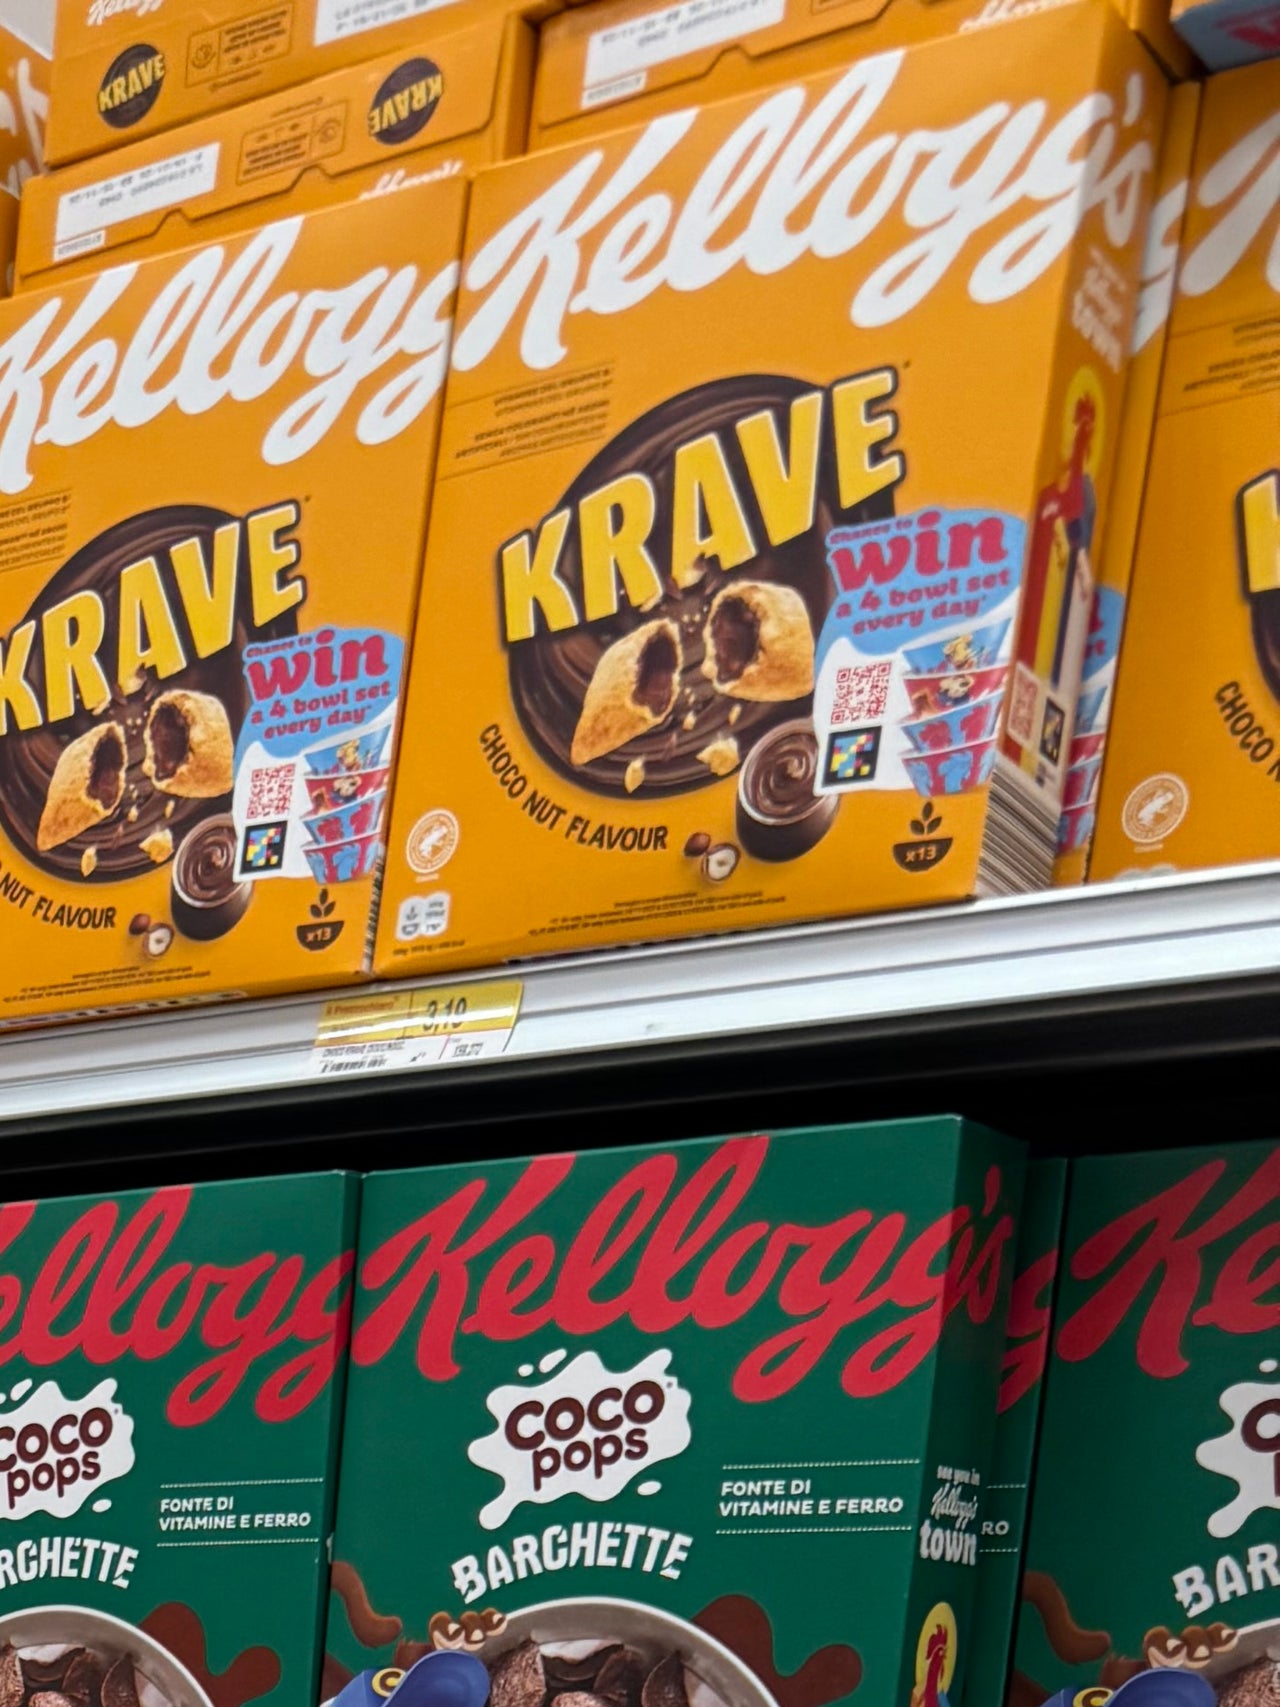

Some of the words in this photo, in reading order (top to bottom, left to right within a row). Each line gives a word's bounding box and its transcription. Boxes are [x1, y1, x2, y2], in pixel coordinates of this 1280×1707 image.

[500, 370, 902, 644] KRAVE
[833, 512, 1009, 594] win
[247, 629, 388, 702] win
[480, 724, 522, 800] CHOCO
[522, 790, 562, 831] NUT
[565, 816, 667, 852] FLAVOUR
[2, 872, 33, 909] NUT
[33, 898, 117, 929] FLAVOUR
[503, 1379, 666, 1454] COCO
[5, 1450, 102, 1509] pops
[531, 1426, 650, 1491] pops
[721, 1480, 786, 1497] FONTE
[789, 1479, 811, 1494] DI
[159, 1499, 212, 1515] FONTE
[216, 1497, 234, 1512] DI
[719, 1500, 813, 1517] VITAMINE
[818, 1500, 831, 1514] E
[835, 1497, 903, 1514] FERRO
[449, 1521, 695, 1604] BARCHETTE
